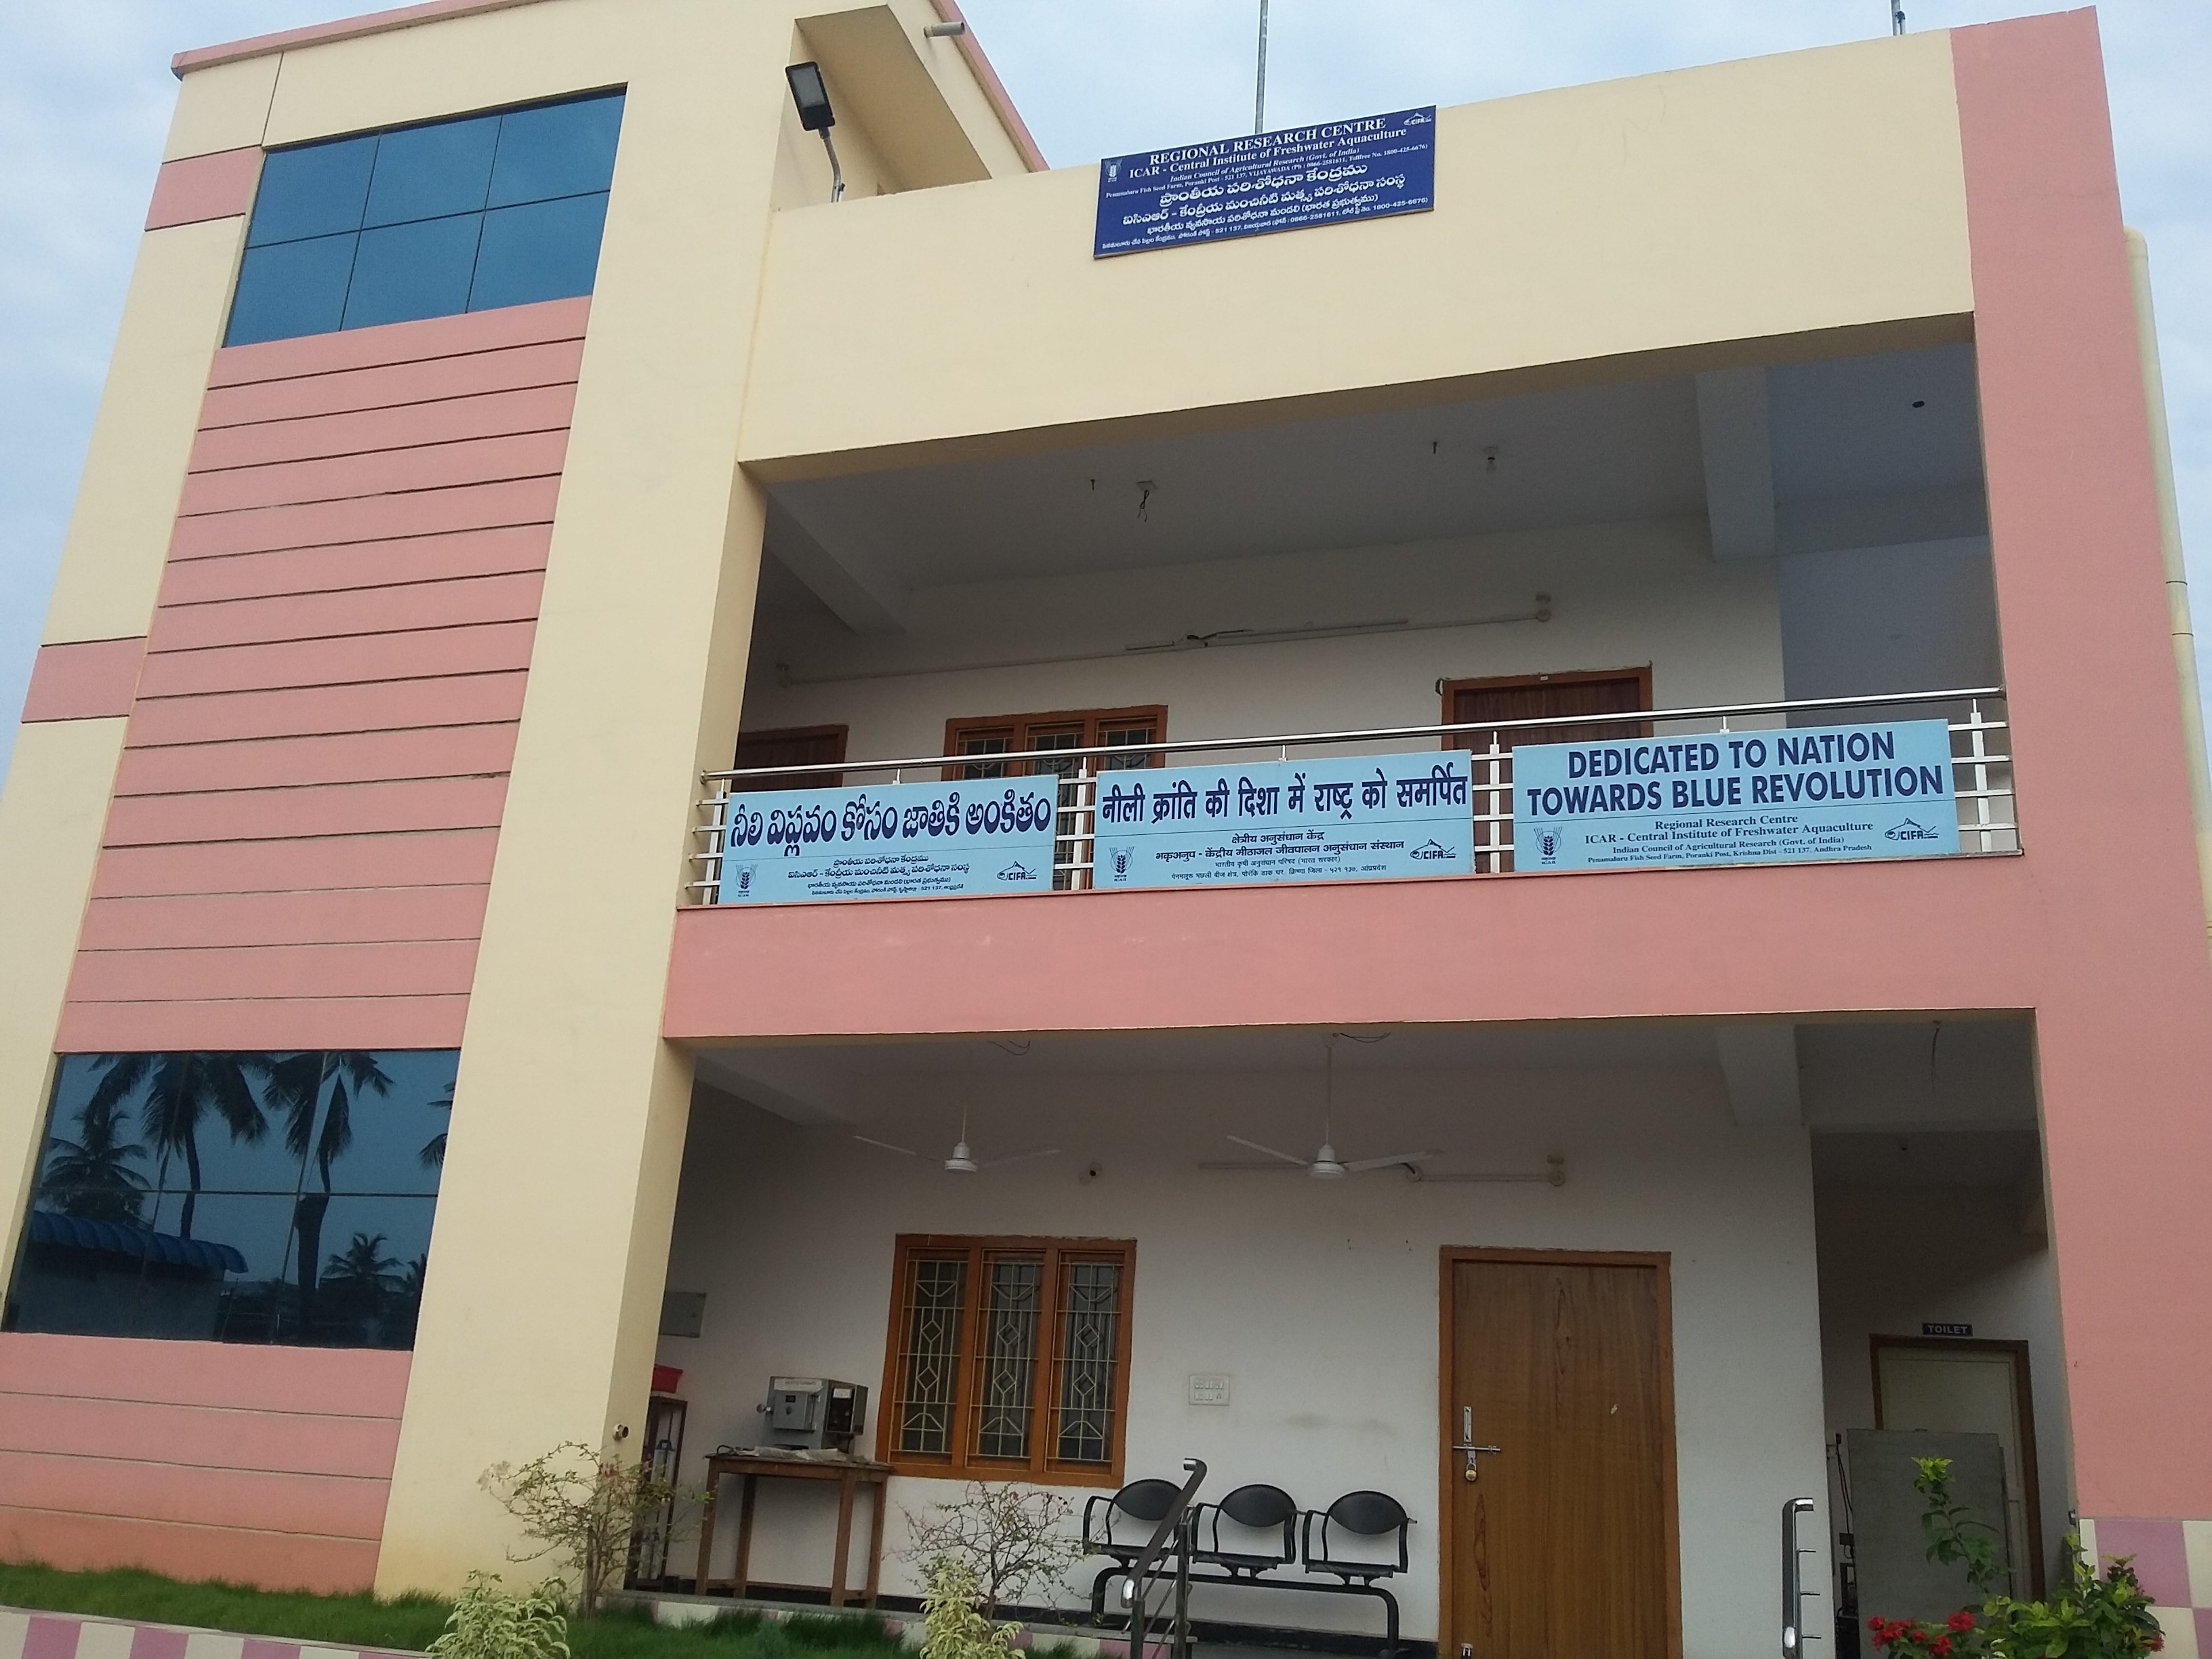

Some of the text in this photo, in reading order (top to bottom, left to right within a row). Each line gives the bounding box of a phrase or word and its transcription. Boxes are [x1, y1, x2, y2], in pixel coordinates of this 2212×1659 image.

[1149, 117, 1386, 165] REGIONAL RESEARCH CENTRE
[1129, 129, 1406, 178] ICAR Central Institute of Freshwater Aquaculture
[1193, 168, 1220, 178] Council
[1229, 160, 1271, 173] Agricultural
[1273, 156, 1304, 166] Research
[1305, 152, 1327, 161] (Govt.
[1338, 148, 1359, 156] India)
[1248, 165, 1290, 176] VIJAYAWADA
[1159, 164, 1367, 207] ప్రాంతీయ పరిశోధనా కేంద్రము
[1179, 202, 1223, 218] కేంద్రీయ
[1314, 180, 1374, 197] పరిశోధనా
[1376, 173, 1405, 189] సంస్థ
[1147, 222, 1184, 234] భారతీయ
[1227, 210, 1268, 222] పరిశోధనా
[1568, 731, 1894, 778] DEDICATED TO NATION
[1102, 762, 1467, 823] नीली क्रांति की दिशा में राष्ट्र को समर्पित
[1527, 764, 1943, 815] TOWARDS BLUE REVOLUTION
[731, 789, 1050, 857] నీలి విప్లవం కోసం జాతికి అంకితం
[1585, 822, 1873, 843] ICAR Central Institute of Freshwater Aquaculture
[1655, 815, 1797, 830] Regional Research Centre
[1231, 829, 1324, 845] क्षेत्रीय अनुसंधान केंद्र
[1685, 841, 1736, 851] Agricultural
[1738, 839, 1776, 847] Research
[1900, 830, 1923, 840] CIFA
[833, 854, 928, 867] ప్రాంతీయ పరిశోధనా కేంద్రము
[1155, 839, 1404, 862] भकृअनुप केंद्रीय मीठाजल जीवपालन अनुसंधान संस्थान
[1423, 850, 1443, 859] CIFA
[825, 867, 853, 878] కేంద్రీయ
[912, 863, 949, 873] పరిశోధనా
[1008, 872, 1026, 880] CIFA
[1928, 1325, 1967, 1334] TOILET
